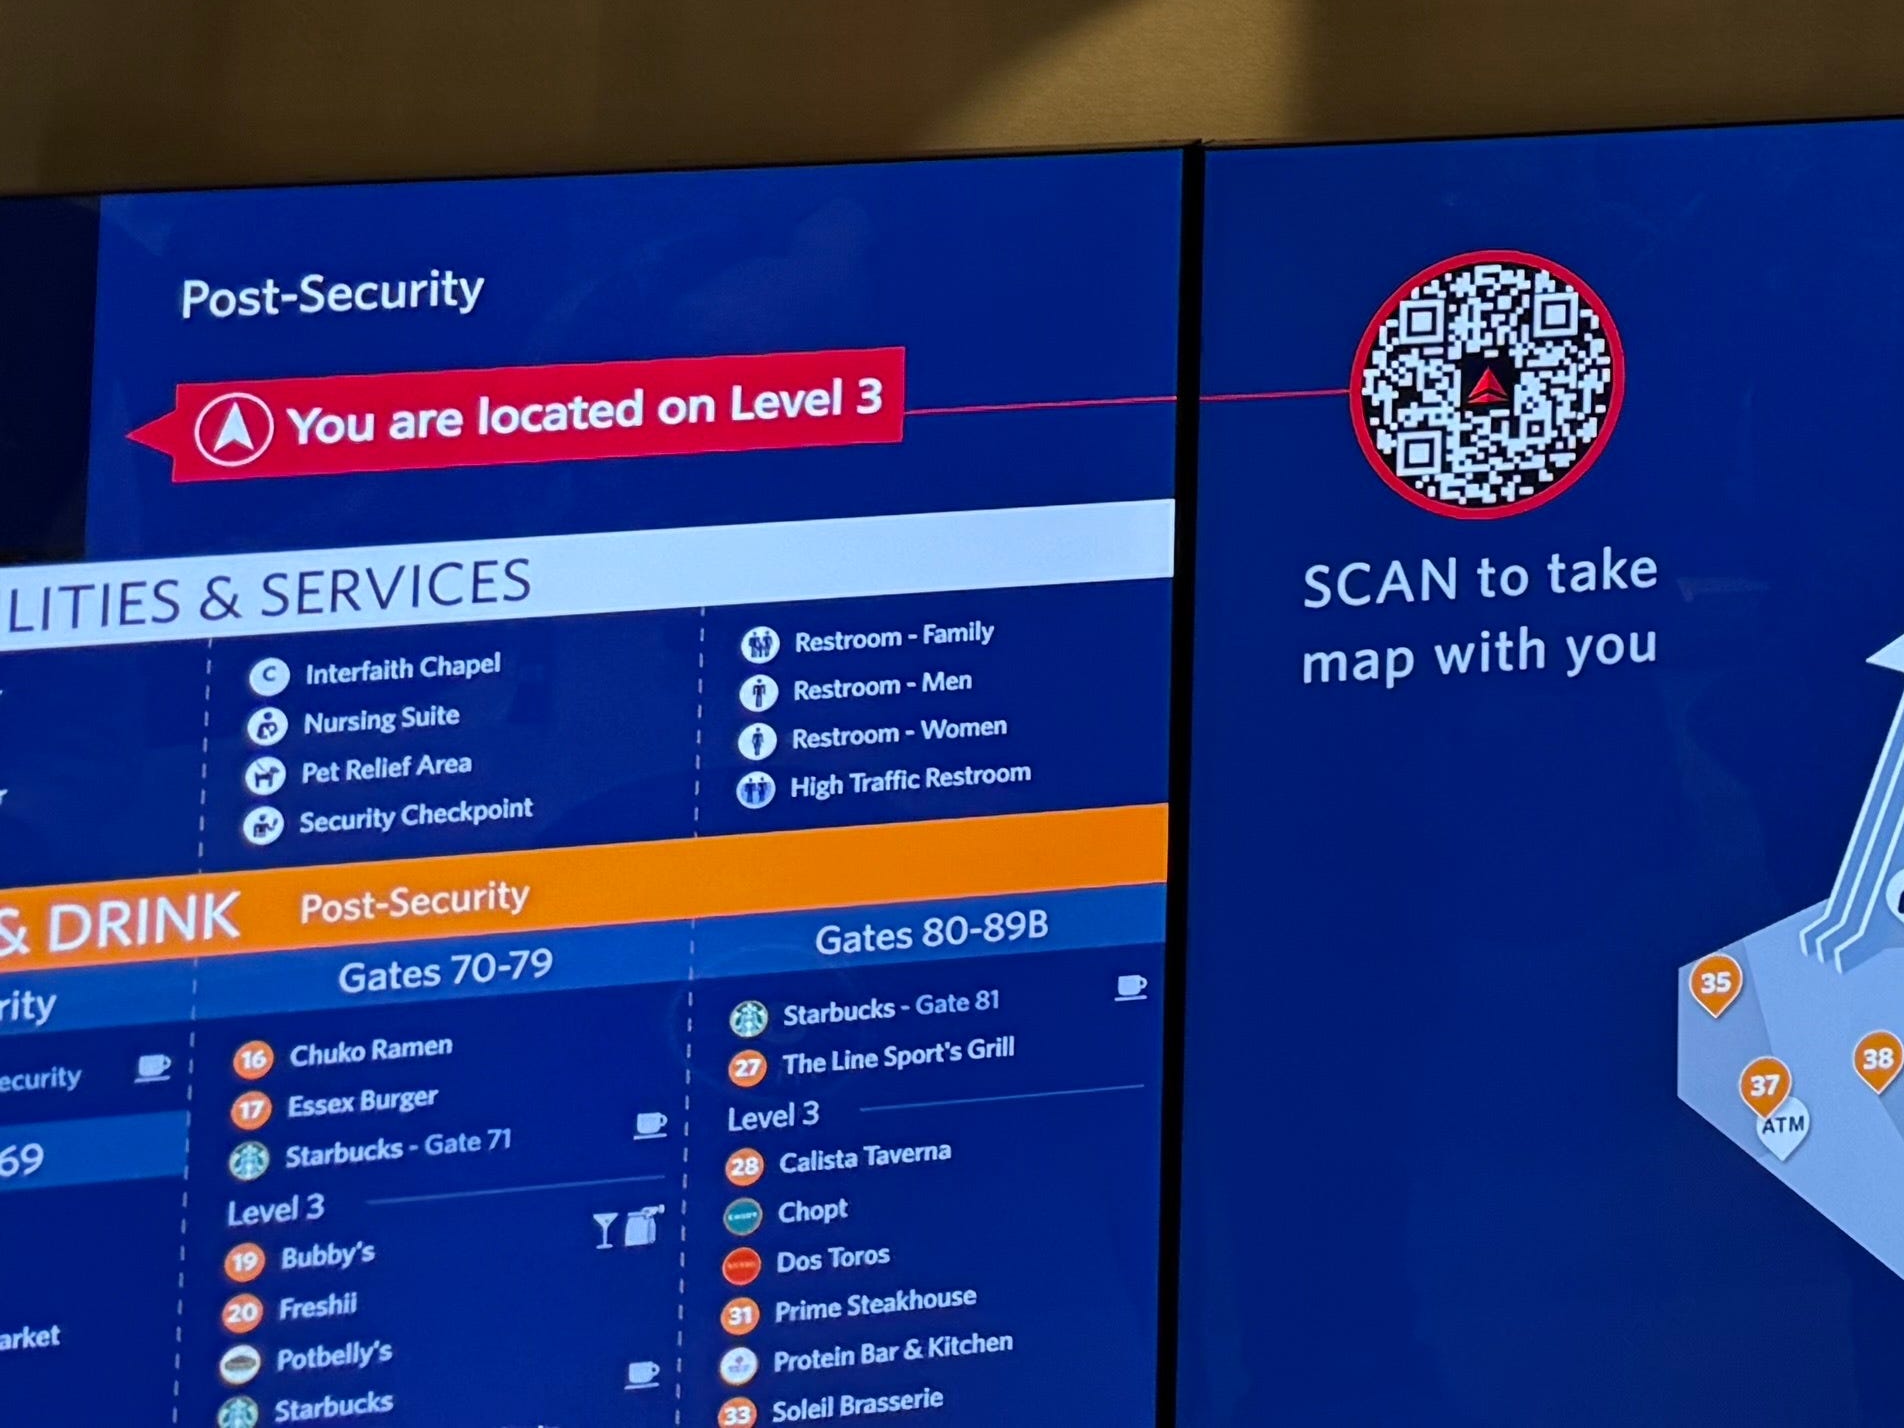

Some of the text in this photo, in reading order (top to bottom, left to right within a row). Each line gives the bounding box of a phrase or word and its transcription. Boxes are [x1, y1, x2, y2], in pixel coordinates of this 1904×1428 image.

[183, 269, 484, 318] Post-Security
[287, 378, 882, 444] You are located on Level 3
[200, 558, 530, 621] & SERVICES
[1304, 546, 1657, 608] SCAN to take
[307, 652, 500, 684] Interfaith Chapel
[1304, 626, 1655, 689] map with you
[791, 766, 1031, 800] High Traffic Restroom
[49, 881, 530, 953] DRINK Post-Security
[816, 910, 1048, 955] Gates 80-89B
[339, 948, 552, 993] Gates 70-79
[242, 1039, 453, 1069] 16 Chuko Ramen
[735, 1059, 761, 1077] 27
[782, 1053, 826, 1074] The
[832, 1050, 878, 1071] Line
[967, 1036, 1014, 1059] Grill
